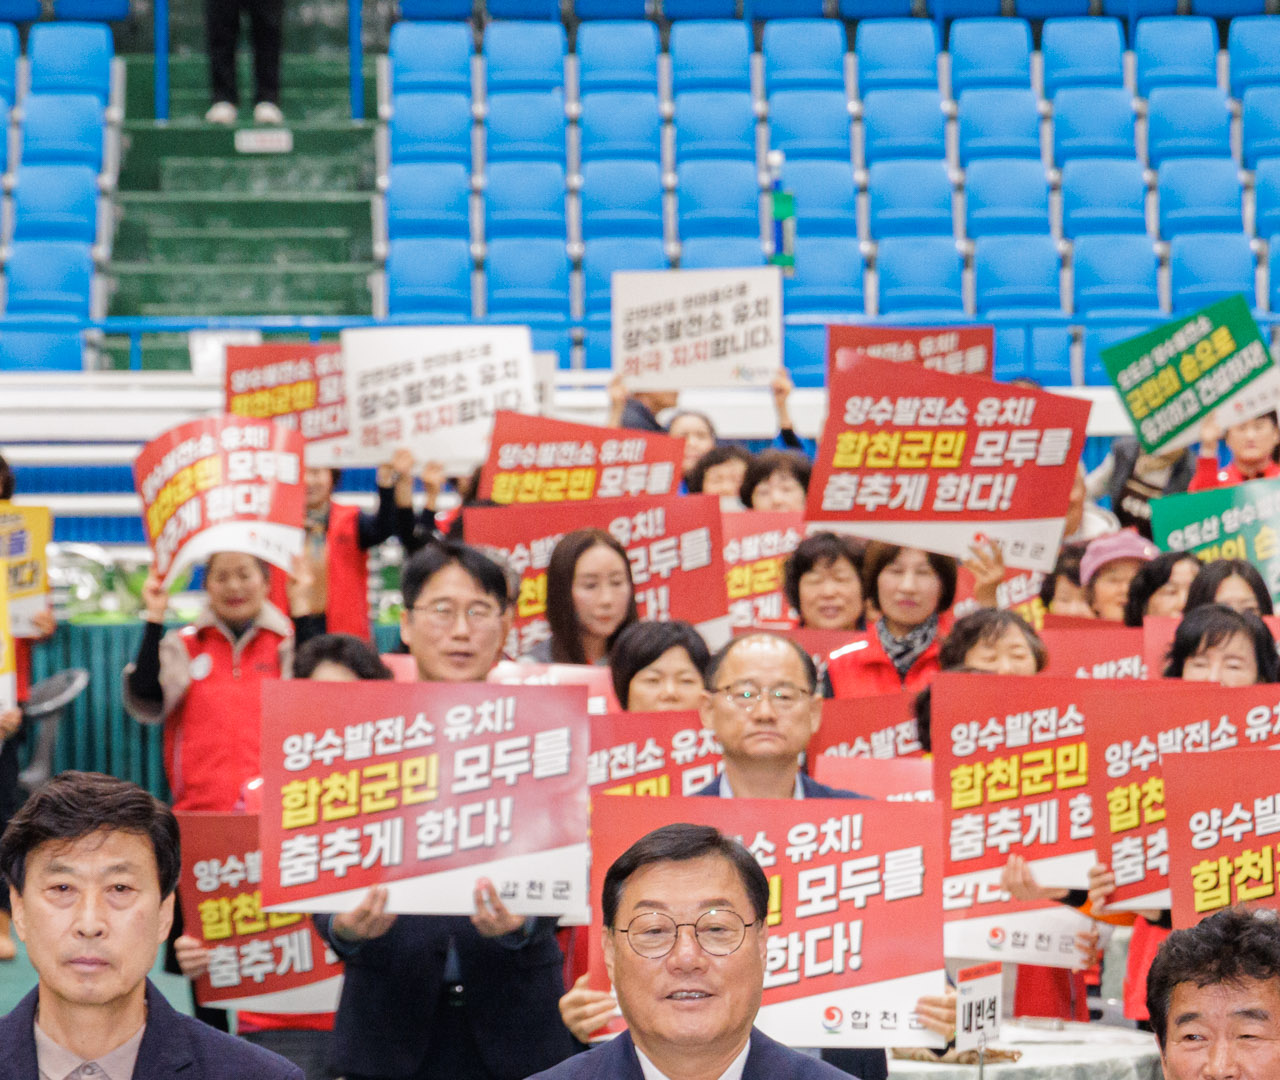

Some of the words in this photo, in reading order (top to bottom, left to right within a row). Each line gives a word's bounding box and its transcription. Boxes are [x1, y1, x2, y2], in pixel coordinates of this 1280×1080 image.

[358, 370, 468, 420] 양수발전소
[843, 395, 969, 426] 양수발전소
[973, 396, 1037, 427] 유치!
[227, 450, 300, 485] 모두를
[832, 430, 968, 469] 합천군민
[970, 427, 1073, 468] 모두를
[206, 484, 270, 522] 한다!
[596, 461, 675, 499] 모두를
[821, 472, 929, 512] 춤추게
[932, 473, 1018, 512] 한다!
[608, 507, 666, 547] 유치!
[282, 711, 437, 772] 양수발전소
[443, 697, 517, 741] 유치!
[949, 703, 1086, 758] 양수발전소
[1104, 714, 1239, 778] 양수발전소
[280, 752, 441, 831] 합천군민
[450, 727, 573, 795] 모두를
[949, 740, 1089, 811] 합천군민
[278, 816, 404, 888] 춤추게
[416, 797, 514, 860] 한다!
[785, 812, 864, 863] 유치!
[948, 799, 1059, 863] 춤추게
[794, 844, 926, 919] 모두를
[207, 928, 313, 989] 춤추게
[762, 919, 863, 990] 한다!
[962, 996, 997, 1034] 내빈석
